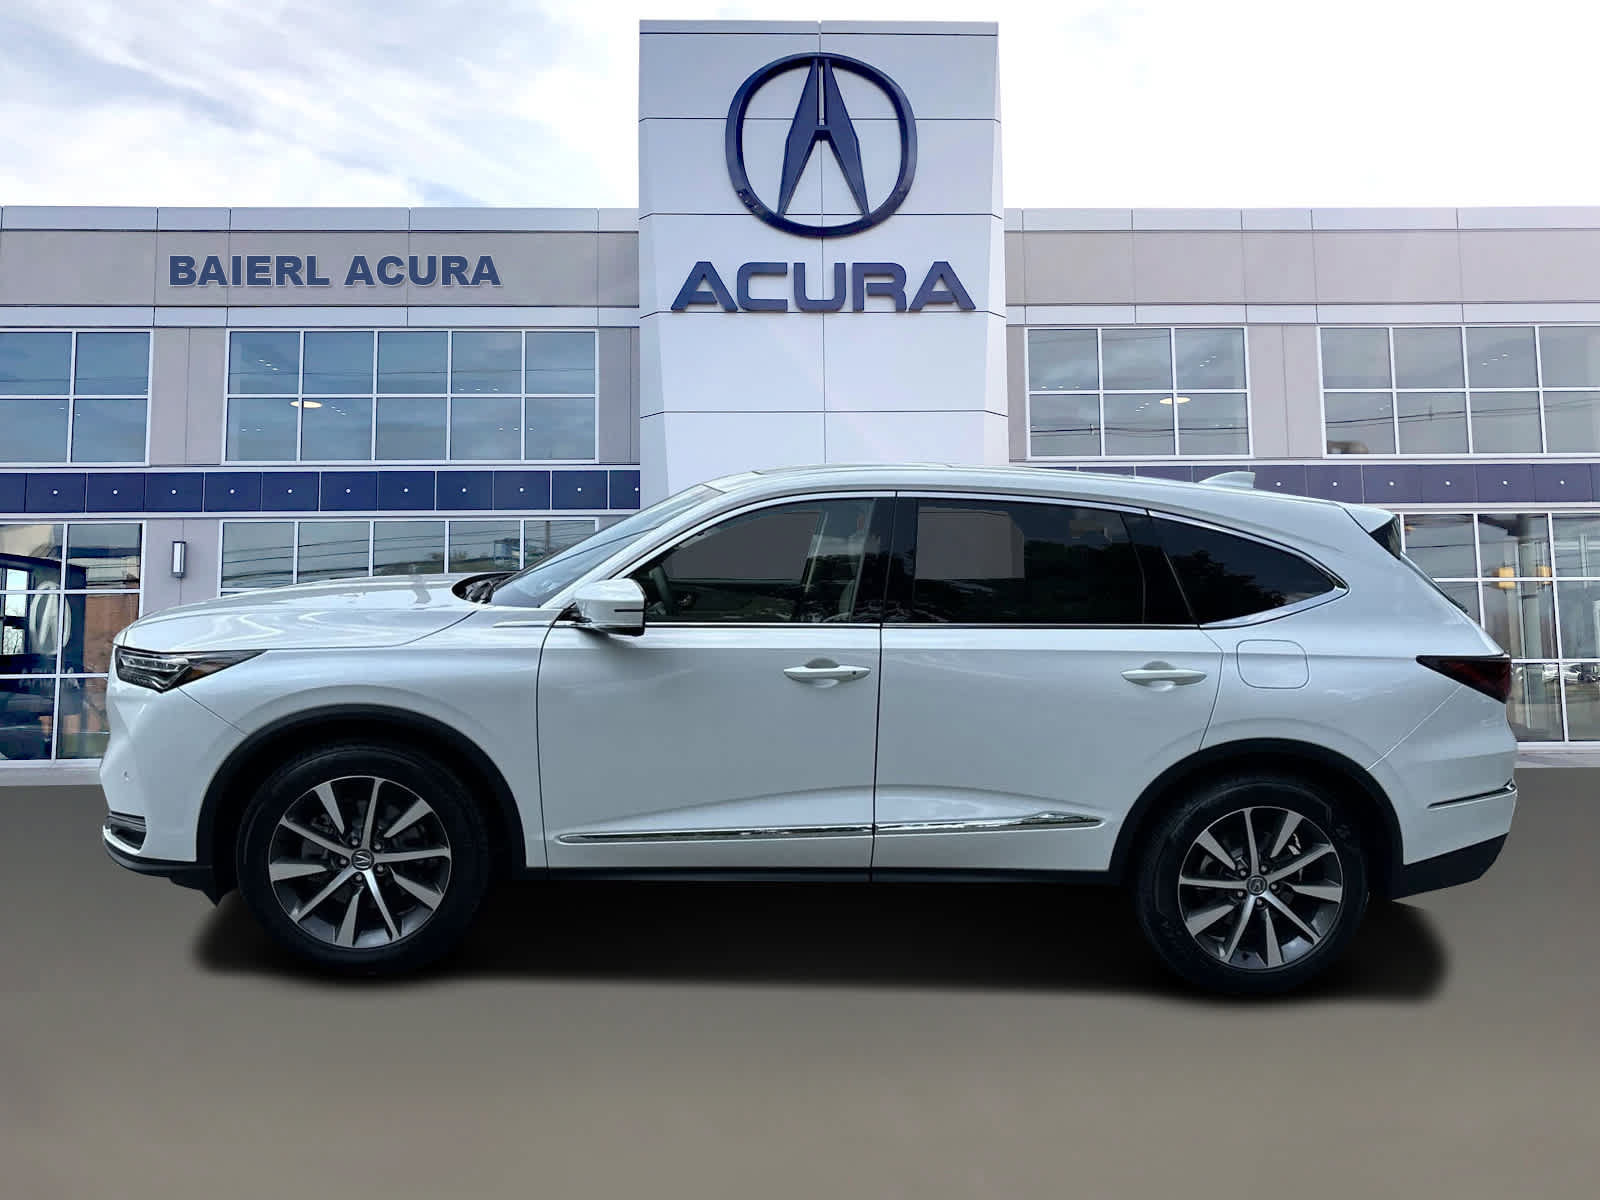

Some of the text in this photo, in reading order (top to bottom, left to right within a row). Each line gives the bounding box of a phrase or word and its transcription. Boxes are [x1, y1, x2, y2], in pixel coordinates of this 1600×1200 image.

[169, 255, 502, 287] BAIERL ACURA
[670, 260, 976, 313] ACURA
